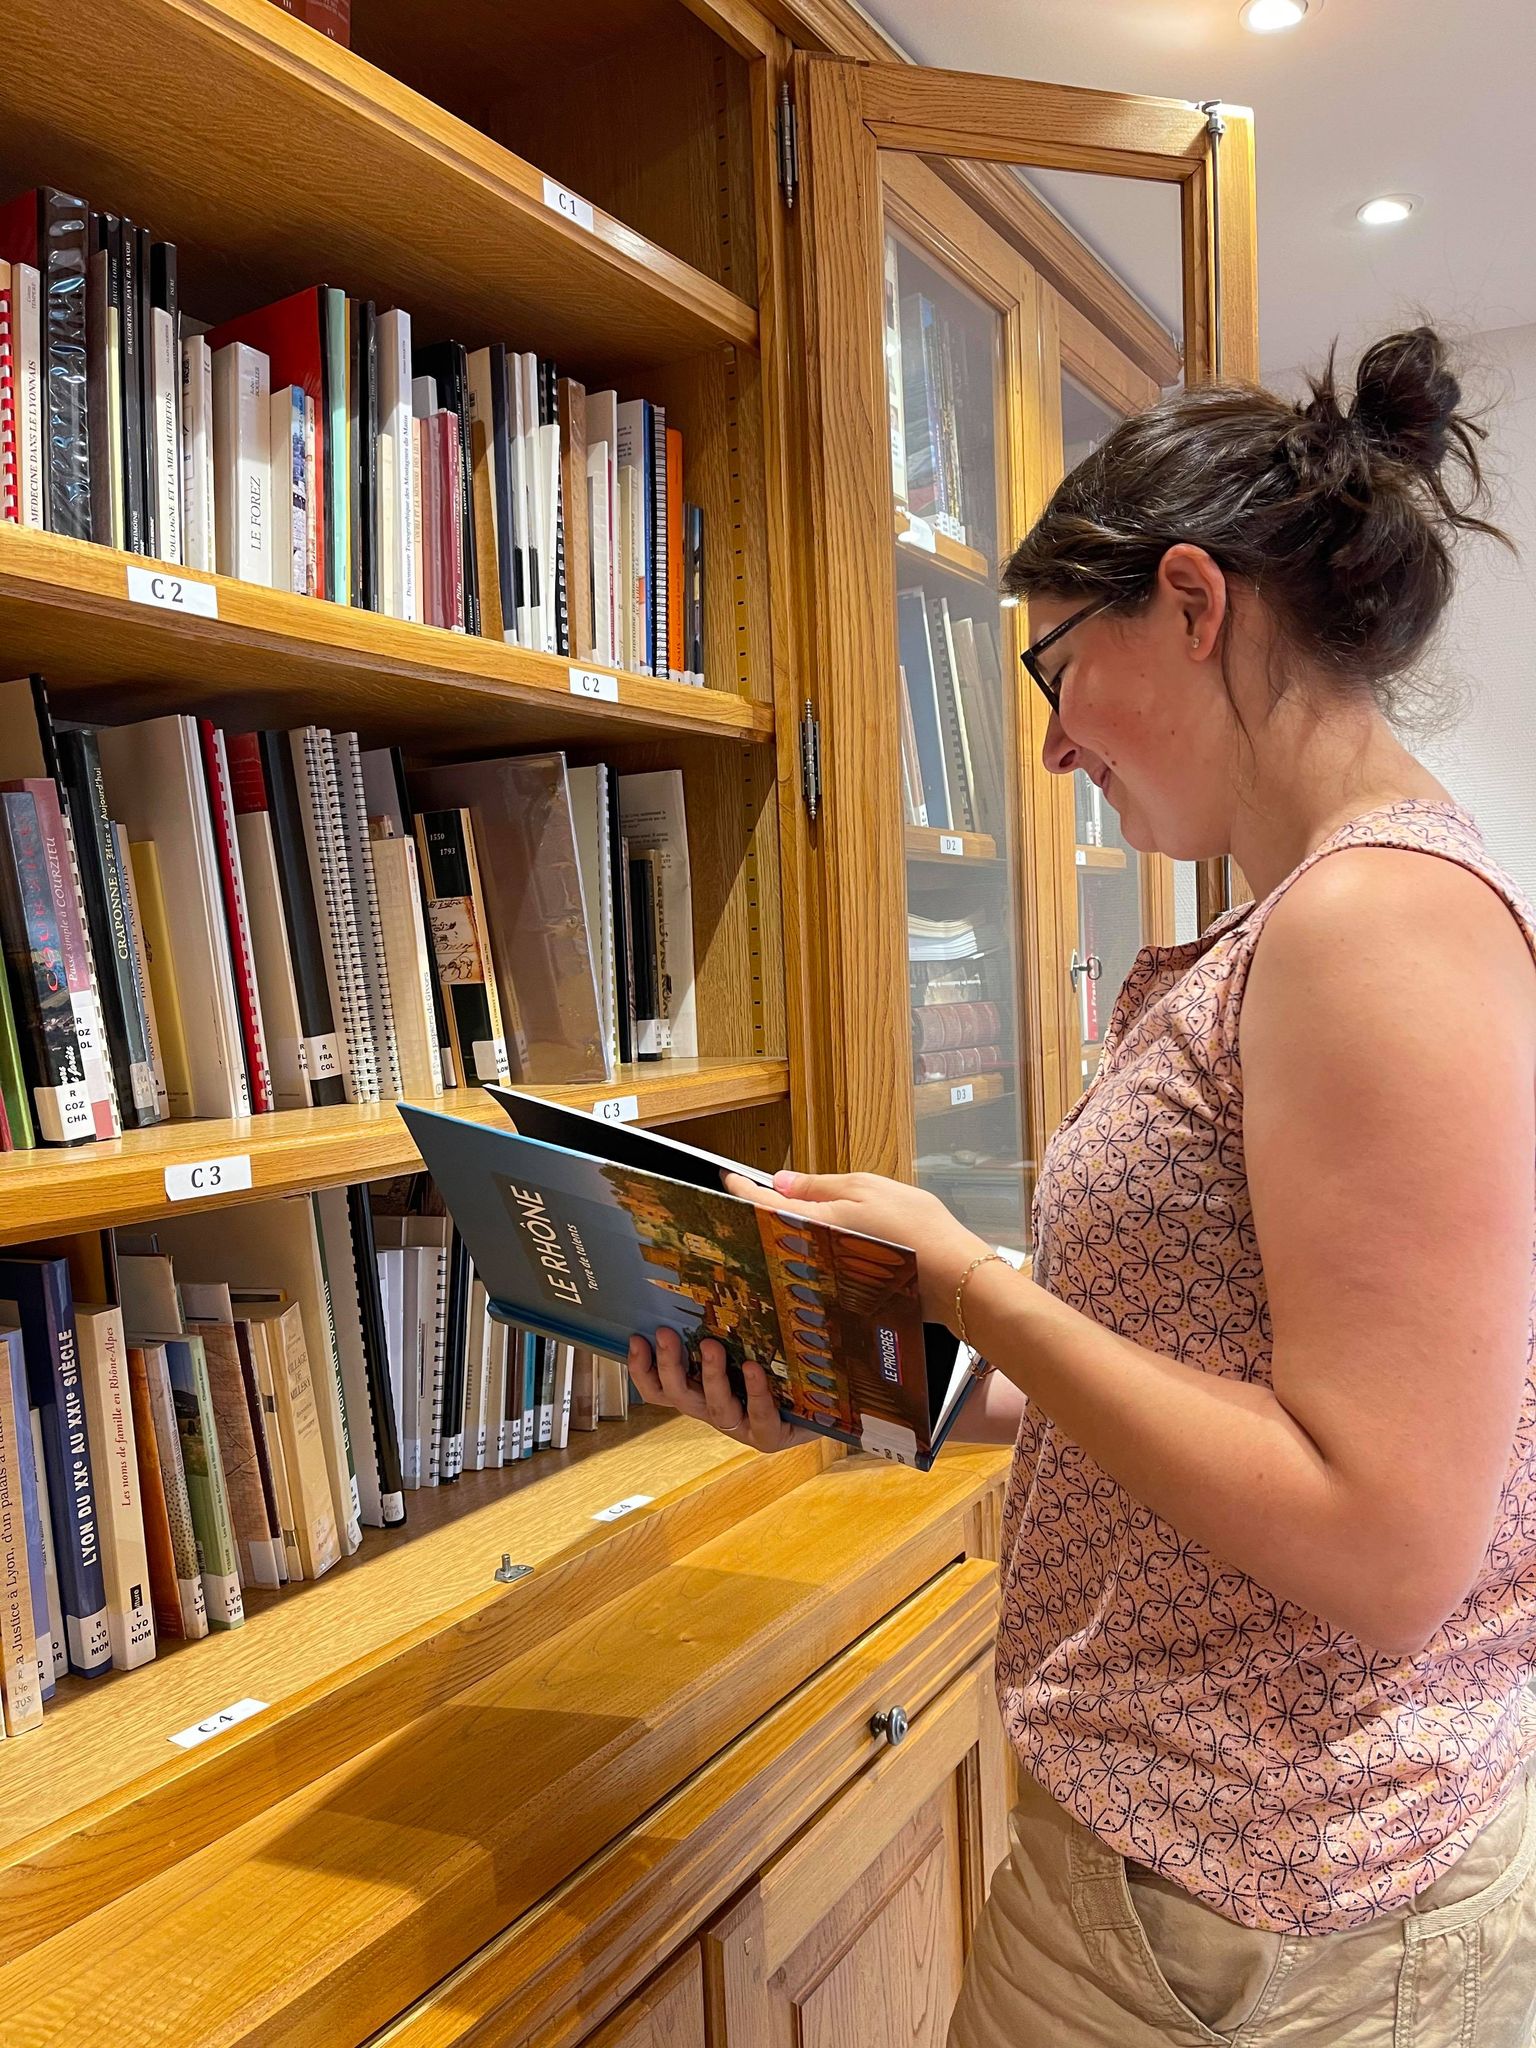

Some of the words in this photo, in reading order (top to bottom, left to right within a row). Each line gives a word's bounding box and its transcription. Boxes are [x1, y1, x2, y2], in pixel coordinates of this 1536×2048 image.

[126, 267, 132, 279] DE
[28, 360, 37, 416] LYONNAIS
[29, 417, 37, 432] LE
[165, 392, 173, 444] AUTREFOIS
[30, 434, 38, 463] DANS
[167, 473, 174, 486] LA
[30, 465, 39, 523] MEDECINE
[168, 489, 175, 502] ET
[250, 476, 261, 525] FOREZ
[251, 531, 262, 551] LE
[93, 766, 110, 821] Aujourd'hui
[429, 832, 446, 842] 1550
[440, 847, 456, 857] 1793
[46, 836, 66, 907] COURZIEU
[108, 876, 129, 960] CRAPONNE
[63, 917, 74, 951] simple
[68, 951, 79, 982] Passé
[76, 1017, 83, 1025] R
[78, 1028, 91, 1037] OZ
[80, 1041, 93, 1049] OL
[319, 1053, 334, 1062] FRA
[320, 1062, 335, 1071] COL
[69, 1090, 77, 1098] R
[65, 1100, 86, 1112] COZ
[67, 1113, 88, 1124] CHA
[510, 1184, 571, 1274] RHÔNE
[567, 1223, 587, 1256] talents
[578, 1256, 592, 1269] de
[547, 1274, 583, 1305] LE
[588, 1268, 599, 1291] Terre
[58, 1328, 78, 1388] SIÈCLE
[107, 1326, 119, 1390] Rhône-Alpes
[880, 1328, 898, 1371] PROGRES
[885, 1370, 898, 1383] LE
[112, 1391, 121, 1403] en
[66, 1391, 83, 1431] XXIe
[113, 1405, 128, 1445] famille
[70, 1433, 86, 1456] AU
[119, 1446, 128, 1460] de
[73, 1460, 89, 1497] XXe
[120, 1461, 129, 1488] noms
[0, 1467, 13, 1509] palais
[121, 1489, 132, 1507] Les
[78, 1499, 93, 1526] DU
[2, 1512, 13, 1543] d'un
[79, 1526, 97, 1568] LYON
[7, 1547, 19, 1587] Lyon,
[7, 1590, 18, 1599] à
[229, 1586, 235, 1594] R
[227, 1605, 242, 1617] TIS
[9, 1602, 24, 1652] Justice
[95, 1620, 102, 1629] R
[131, 1619, 149, 1633] LYO
[90, 1629, 107, 1644] LYO
[131, 1629, 152, 1645] NOM
[90, 1640, 110, 1656] MON
[15, 1656, 25, 1665] a
